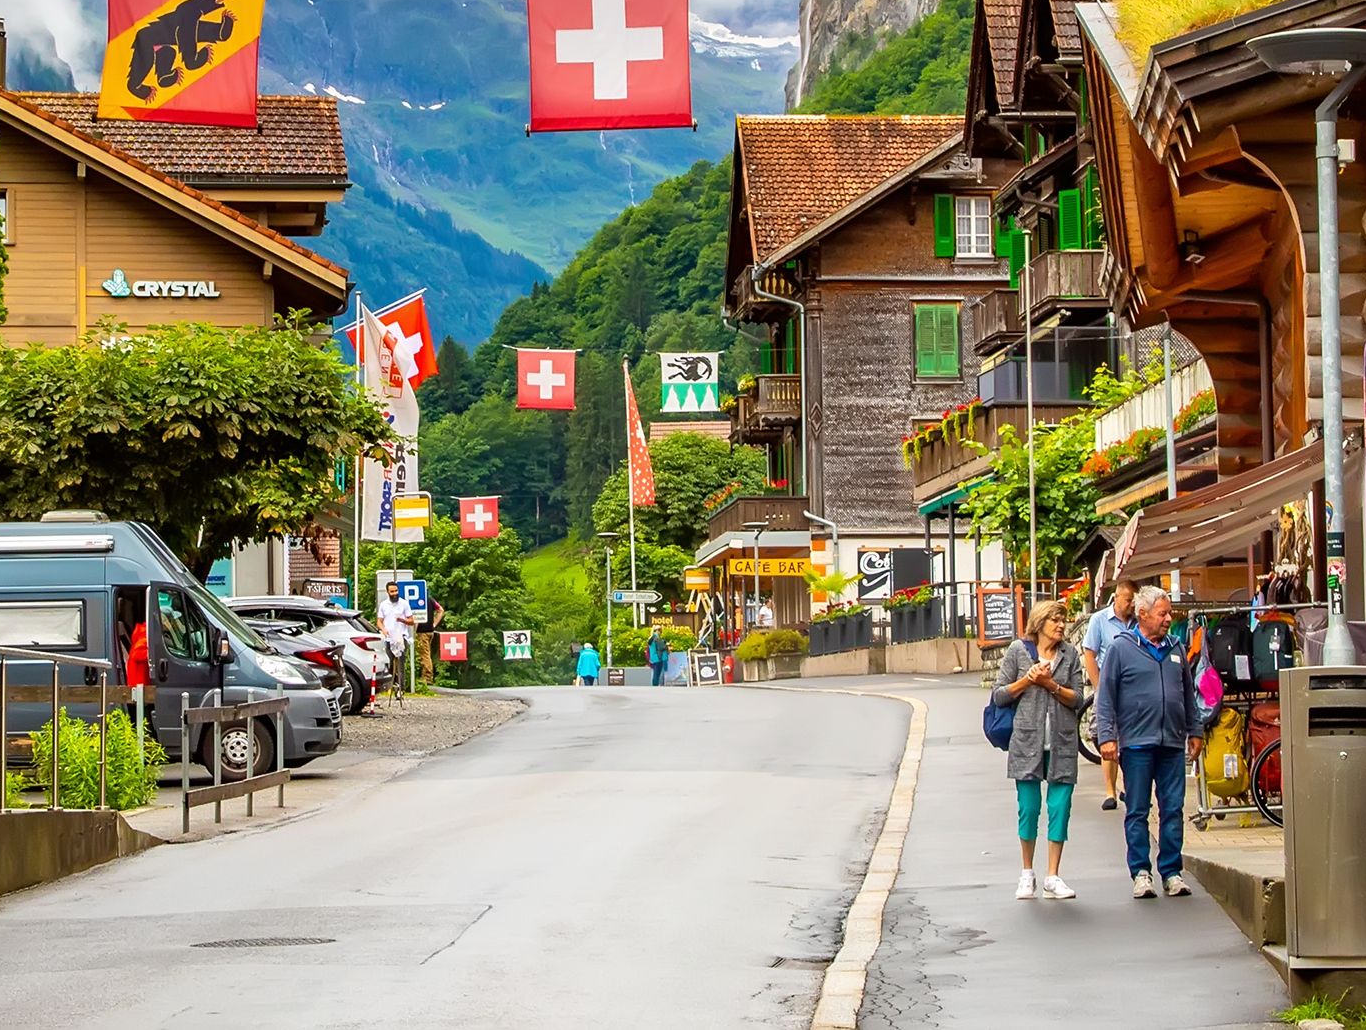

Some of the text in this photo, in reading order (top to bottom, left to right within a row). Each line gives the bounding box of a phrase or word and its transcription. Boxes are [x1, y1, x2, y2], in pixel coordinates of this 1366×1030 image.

[132, 281, 221, 297] CRYSTAL
[735, 560, 805, 573] CAFÉ BAR
[651, 616, 673, 625] hotel
